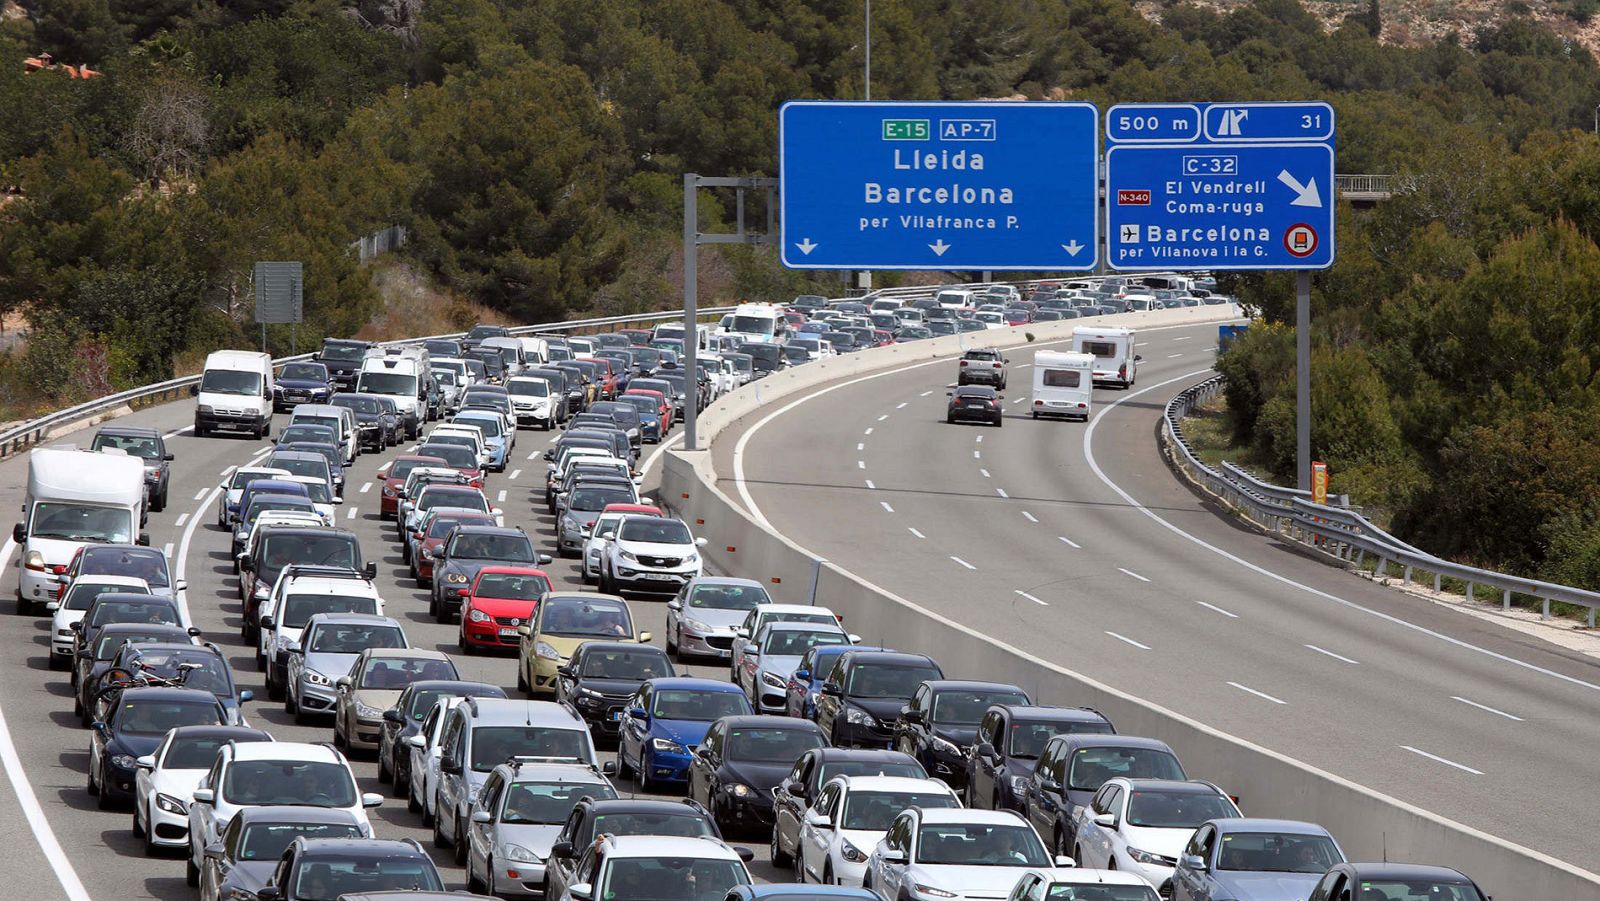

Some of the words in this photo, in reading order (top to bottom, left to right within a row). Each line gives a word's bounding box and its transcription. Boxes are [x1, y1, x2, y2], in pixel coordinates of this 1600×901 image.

[1119, 117, 1159, 131] 500
[1172, 120, 1188, 130] m
[1301, 115, 1320, 129] 31
[886, 124, 926, 137] E-15
[944, 124, 992, 137] AP-7
[894, 150, 984, 170] Lleida
[1187, 159, 1234, 173] C-32
[865, 183, 1013, 204] Barcelona
[1166, 182, 1182, 194] El
[1191, 181, 1265, 194] Vendrell
[1120, 193, 1149, 202] N-340
[1166, 201, 1264, 216] Coma-ruga
[860, 218, 889, 231] per
[900, 216, 996, 229] Vilafranca
[1007, 216, 1019, 229] P.
[1147, 226, 1270, 242] Barcelona
[1119, 249, 1144, 260] per
[1151, 247, 1218, 257] Vilanova
[1234, 247, 1248, 257] la
[1254, 246, 1268, 257] G.
[1315, 472, 1326, 504] SO
